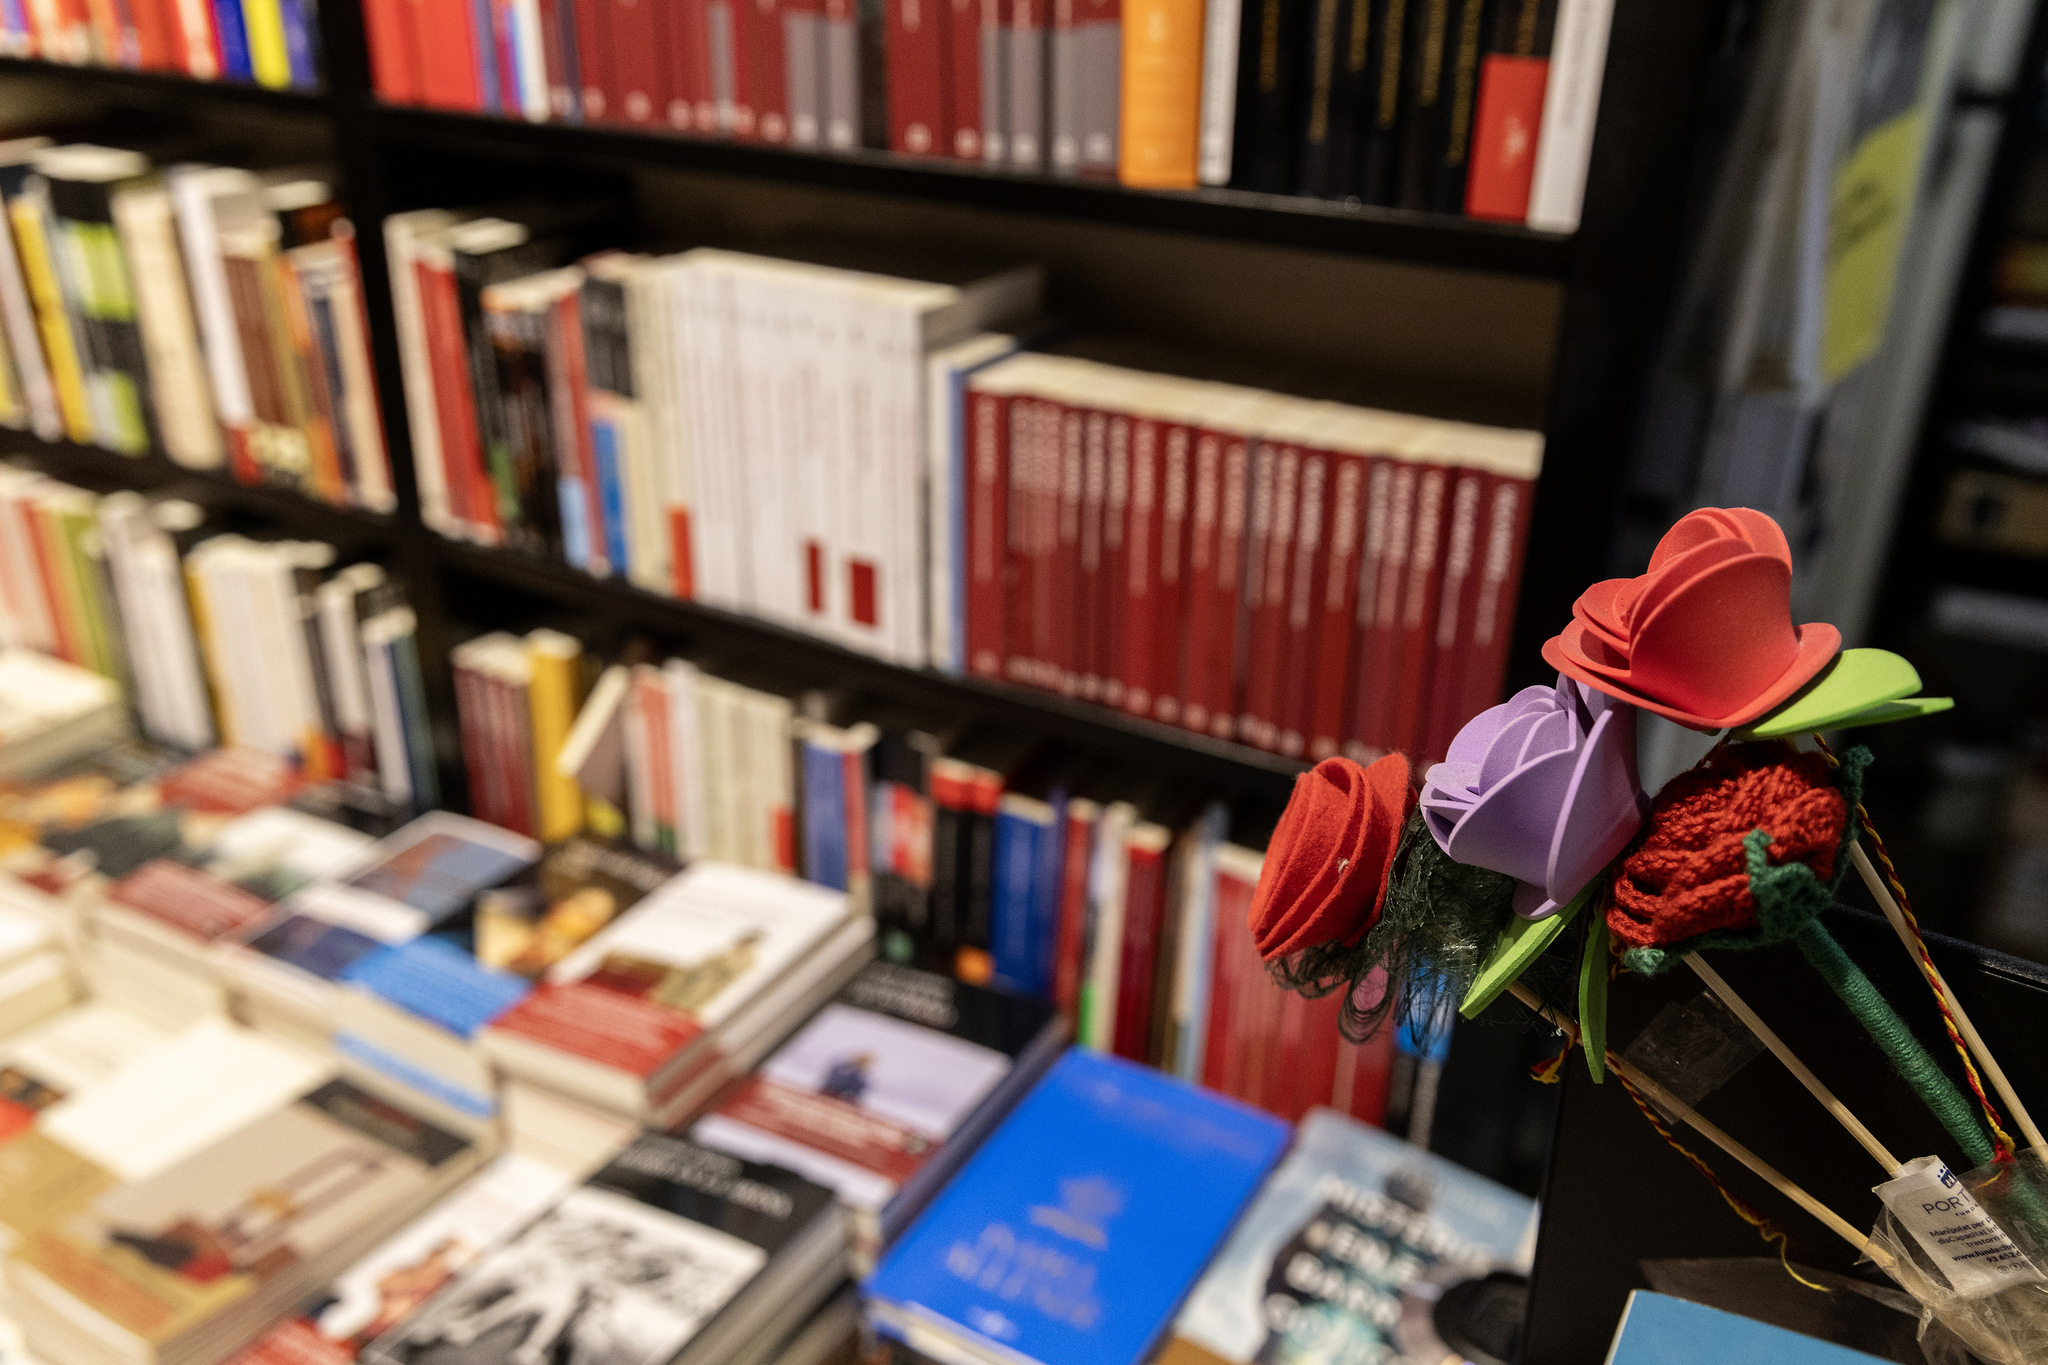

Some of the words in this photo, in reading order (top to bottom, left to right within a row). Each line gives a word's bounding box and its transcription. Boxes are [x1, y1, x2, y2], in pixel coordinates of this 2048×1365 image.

[1929, 1223, 1971, 1238] Manipulat
[1971, 1220, 1985, 1230] per
[1938, 1229, 1987, 1245] disCapacitat
[1966, 1235, 2000, 1248] trastorn
[1986, 1255, 1998, 1263] 93
